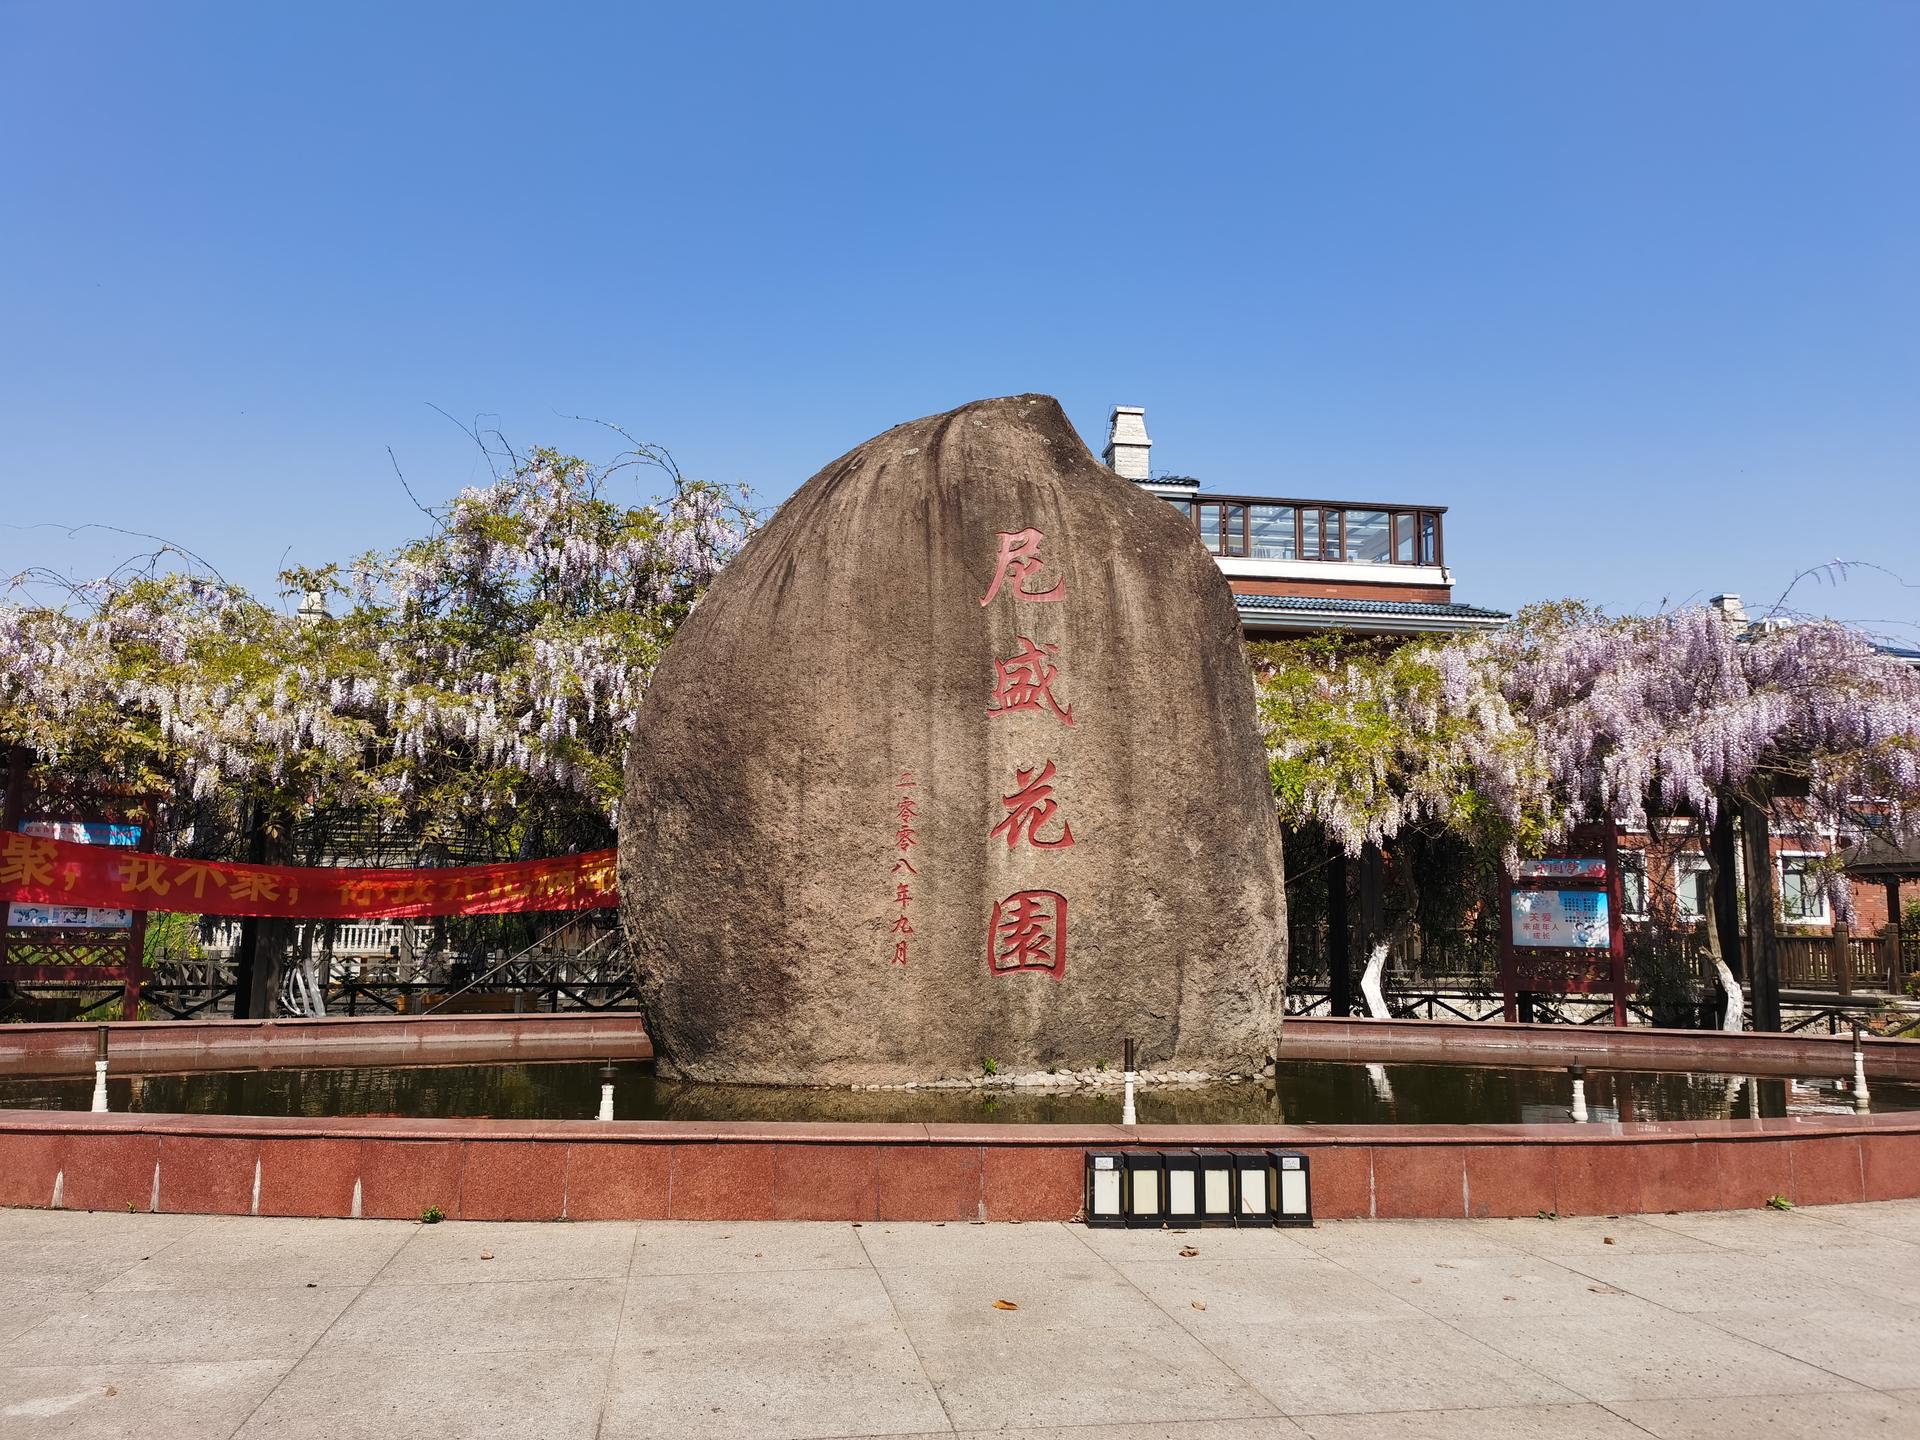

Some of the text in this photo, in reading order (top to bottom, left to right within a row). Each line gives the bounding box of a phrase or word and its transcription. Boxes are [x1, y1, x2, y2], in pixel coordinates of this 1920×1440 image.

[890, 772, 919, 967] 二零零八年九月
[1522, 923, 1560, 931] 未成年人
